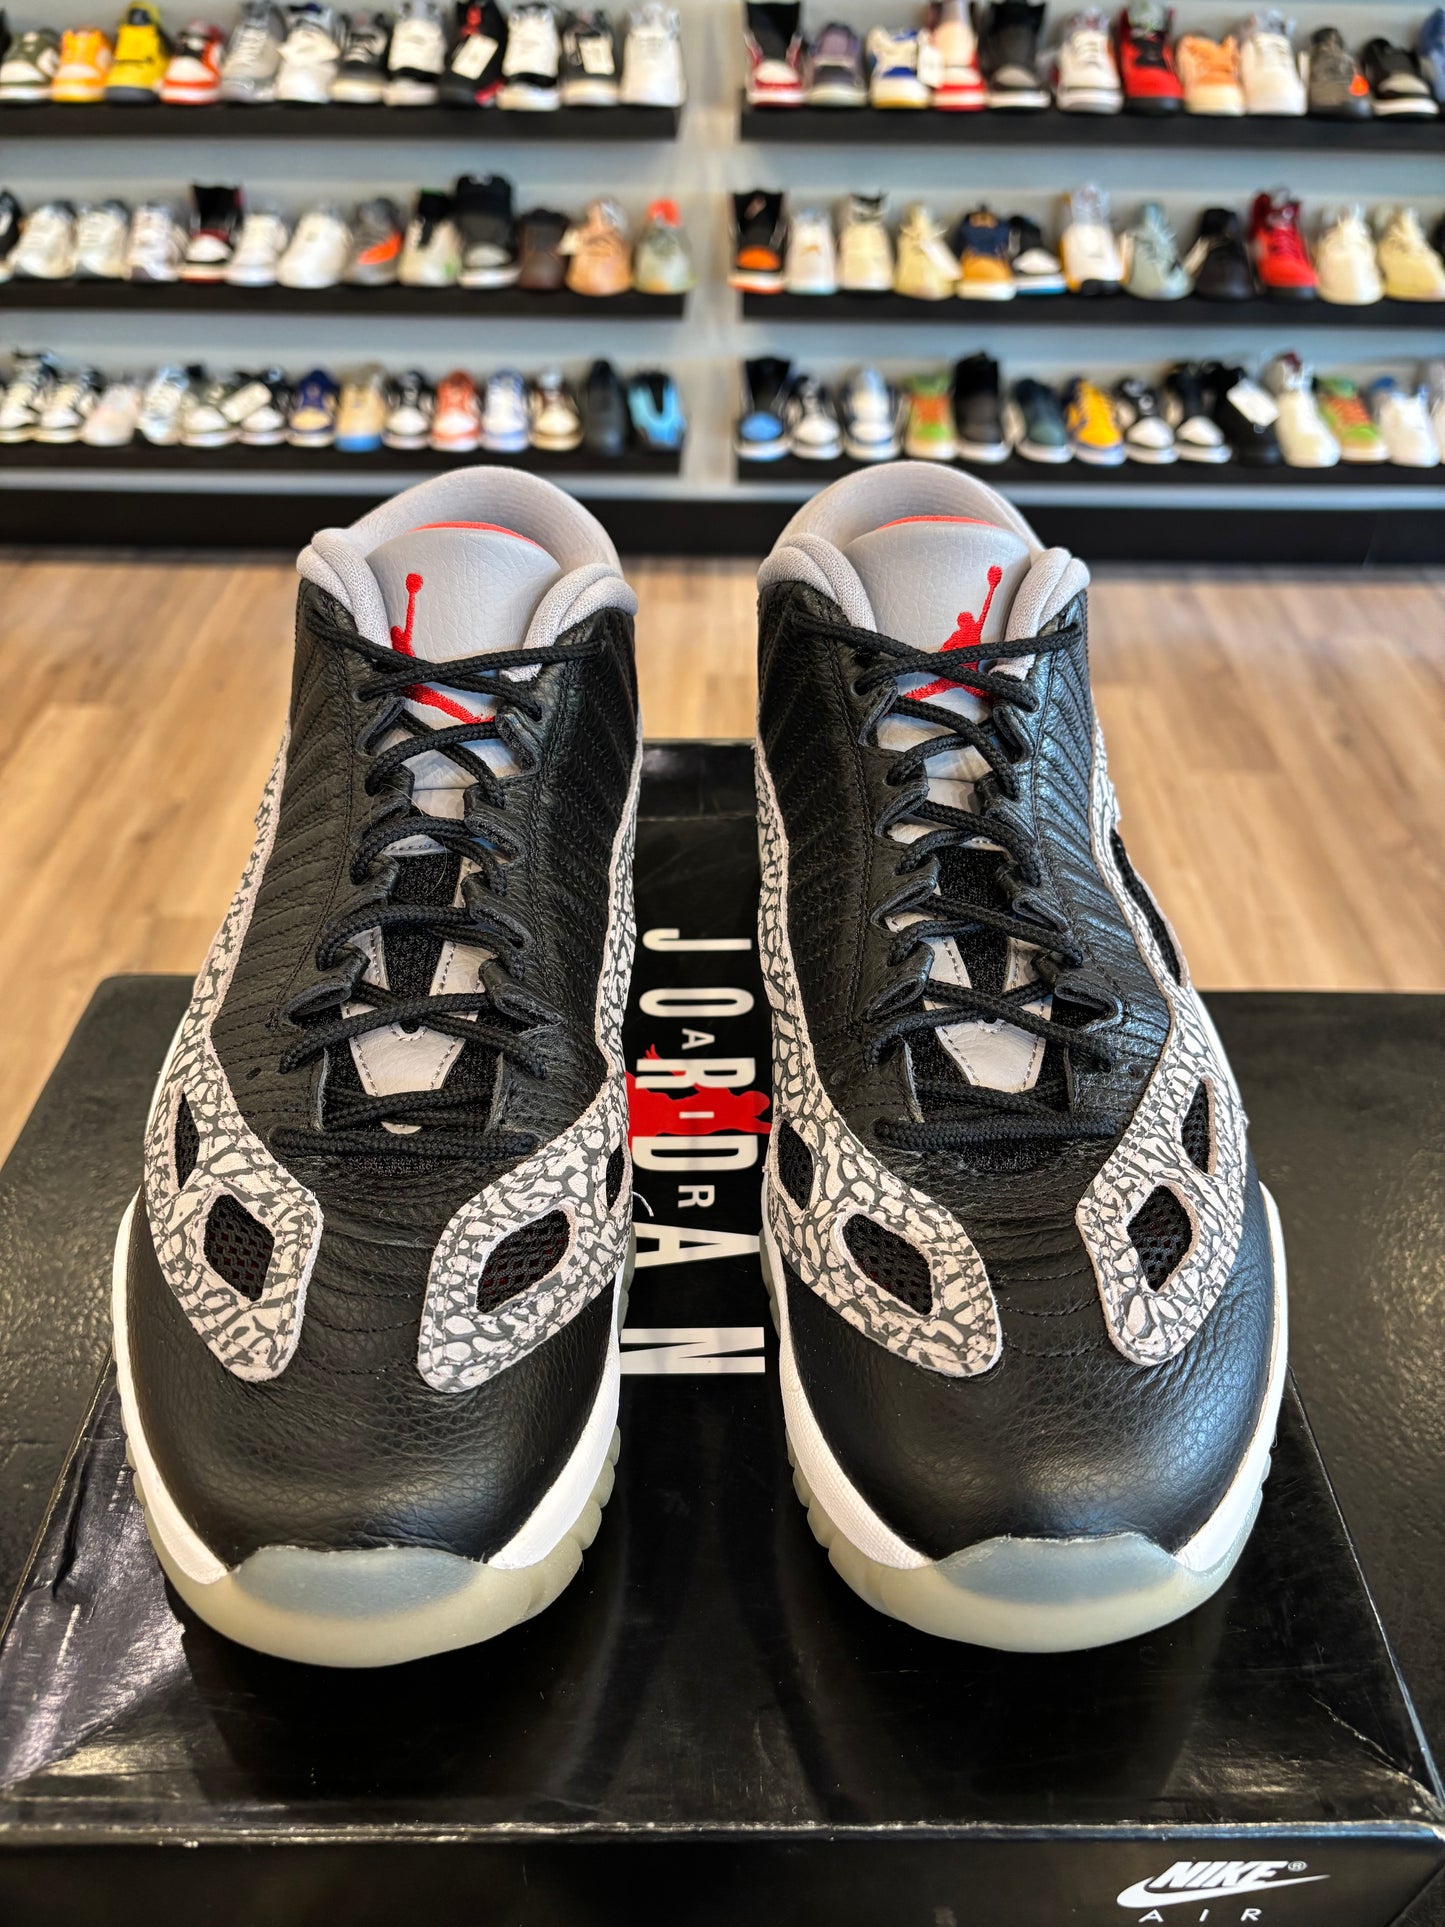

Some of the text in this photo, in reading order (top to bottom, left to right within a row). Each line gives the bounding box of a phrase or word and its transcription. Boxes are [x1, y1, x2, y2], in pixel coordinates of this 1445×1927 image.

[620, 928, 765, 1374] JORDAN
[678, 1028, 715, 1208] AIR
[1138, 1908, 1262, 1923] AIR
